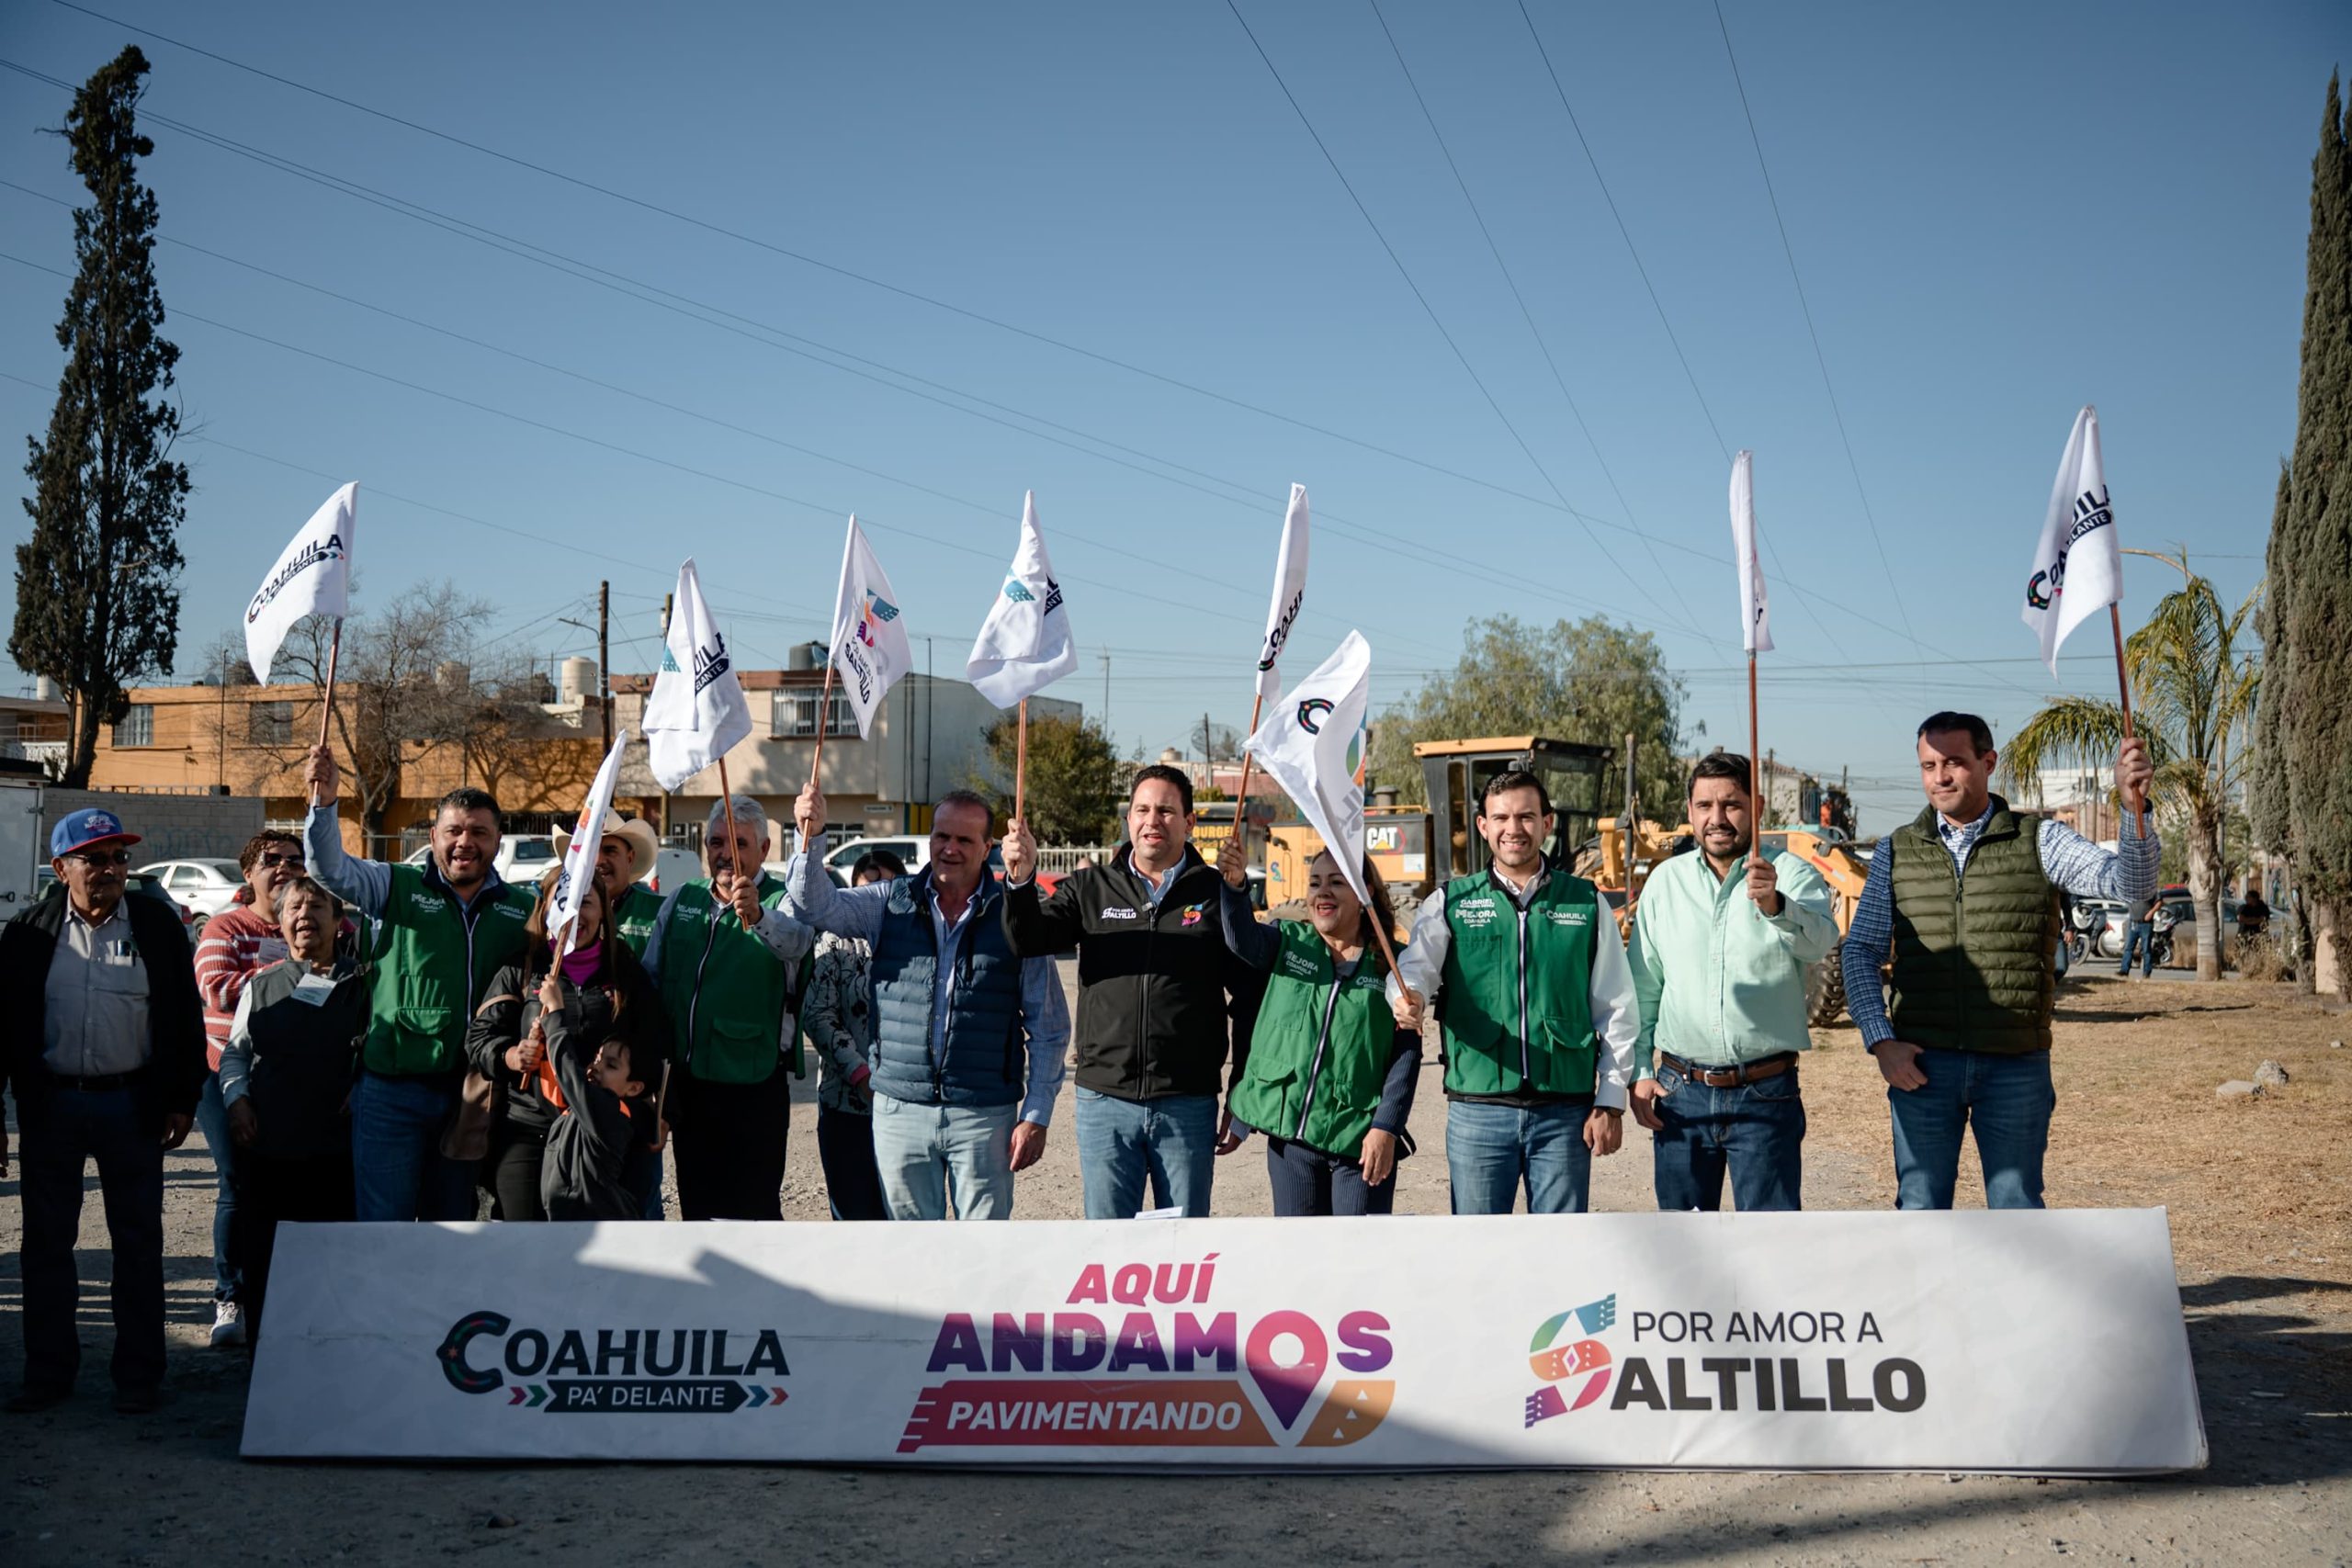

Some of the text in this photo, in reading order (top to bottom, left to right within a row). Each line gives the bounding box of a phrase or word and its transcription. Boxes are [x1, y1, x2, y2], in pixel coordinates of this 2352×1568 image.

[248, 534, 344, 624] COAHUILA
[844, 642, 870, 705] SALTILLO
[1192, 825, 1235, 840] BURGE
[1367, 827, 1397, 851] CAT
[1455, 909, 1498, 919] MEJORA
[1546, 909, 1588, 920] COAHUILA
[1284, 950, 1318, 973] MEJORA
[1066, 1252, 1220, 1307] AQUÍ
[1633, 1311, 1883, 1343] POR AMOR A
[435, 1311, 790, 1394] COAHUILA
[925, 1310, 1393, 1430] ANDAMOS
[611, 1386, 725, 1406] DELANTE
[947, 1401, 1242, 1431] PAVIMENTANDO
